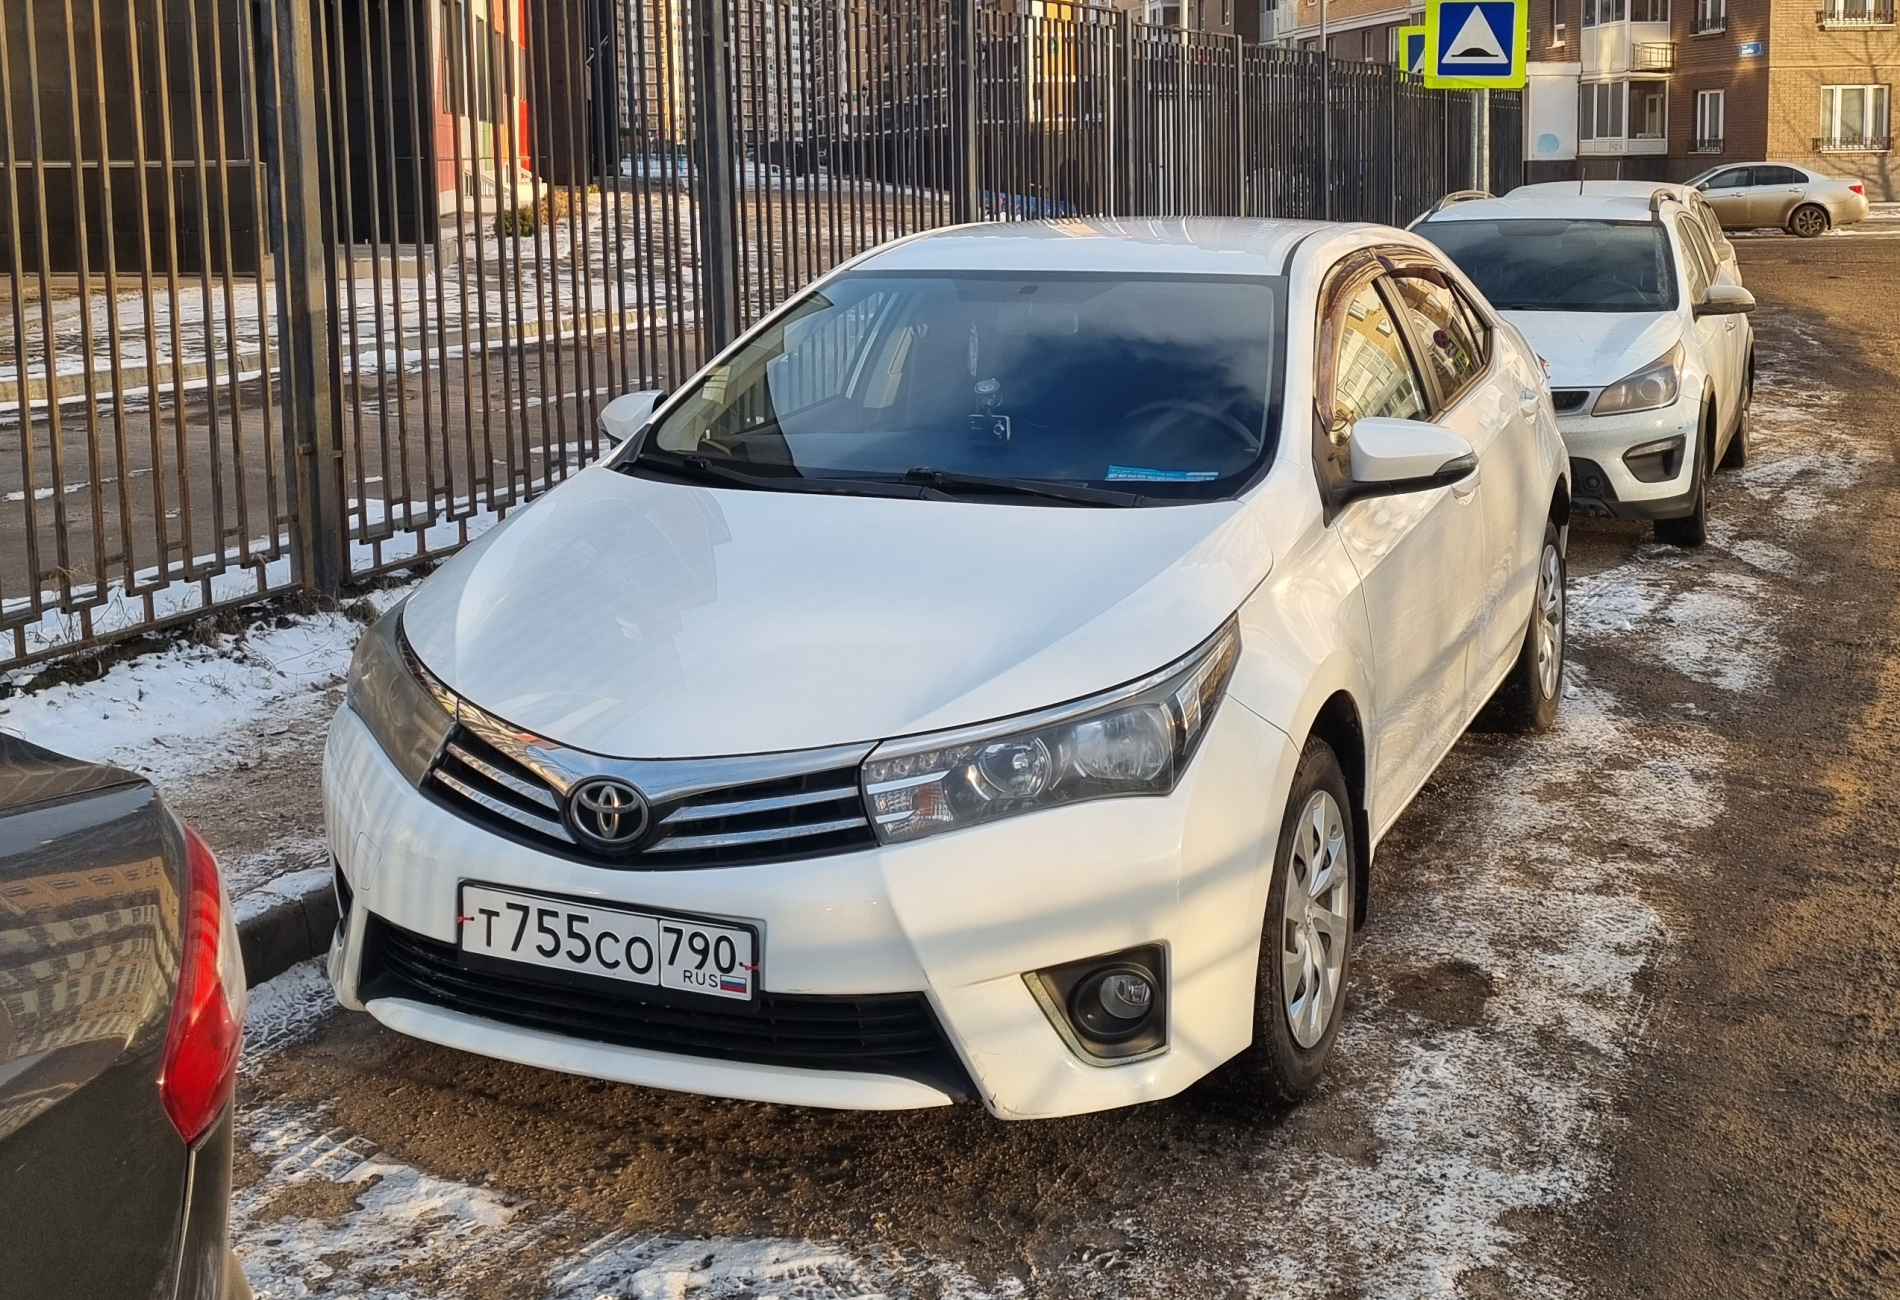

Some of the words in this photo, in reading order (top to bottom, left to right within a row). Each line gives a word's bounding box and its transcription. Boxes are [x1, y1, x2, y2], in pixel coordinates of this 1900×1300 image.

[478, 901, 654, 975] Т755СО
[662, 926, 737, 974] 790
[683, 969, 719, 988] RUS
